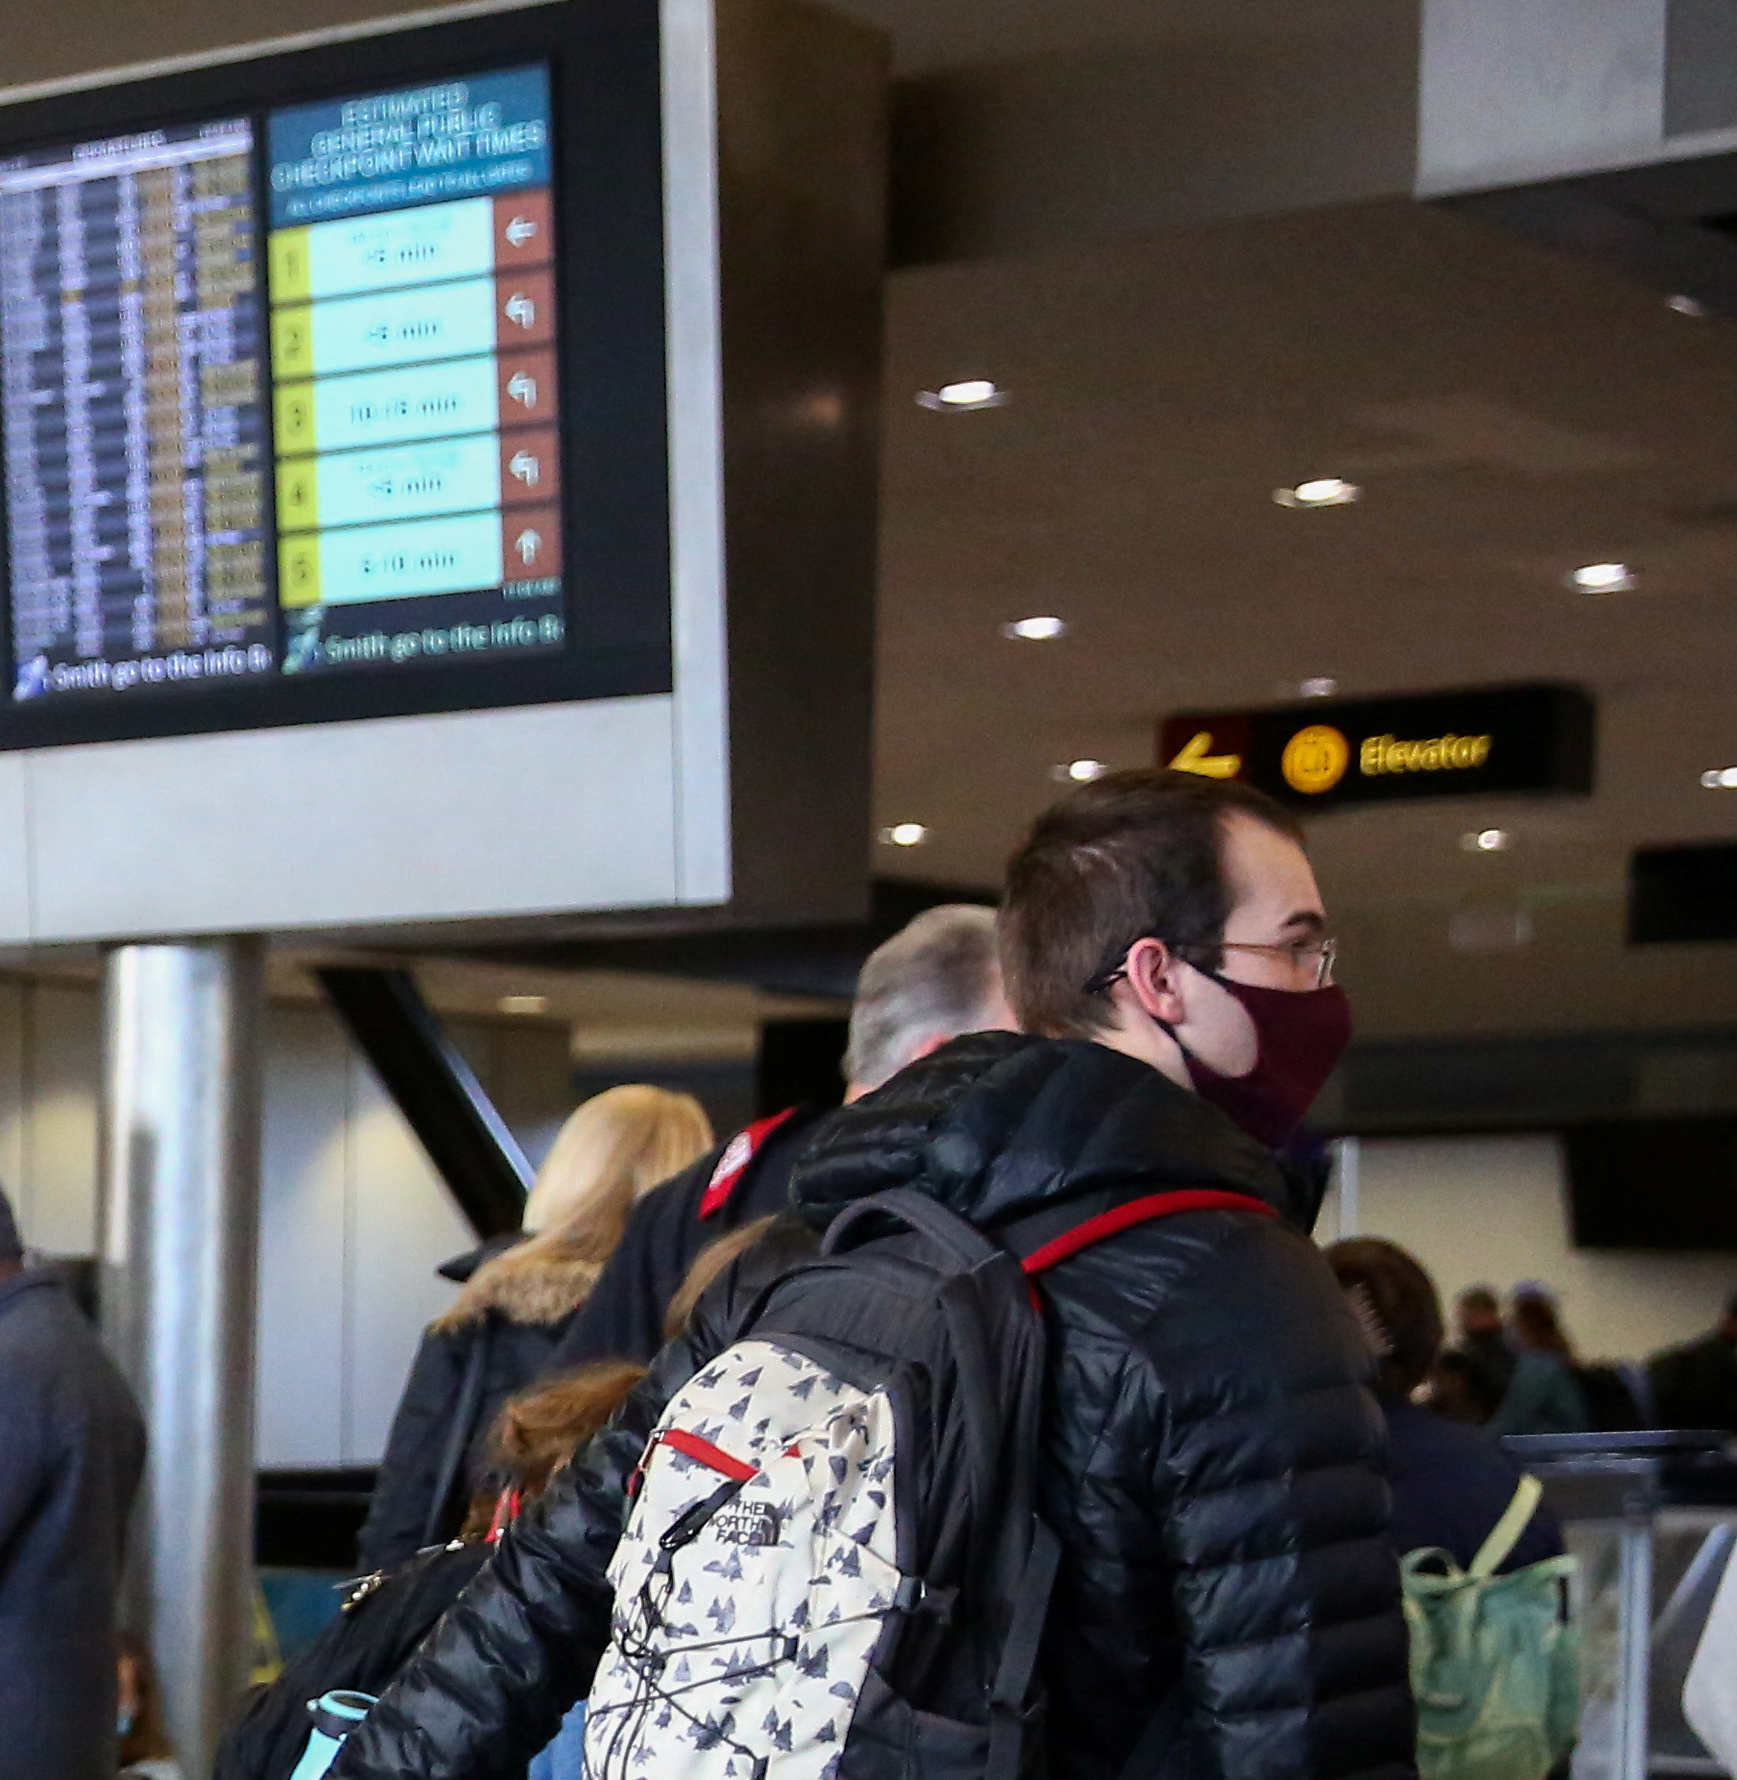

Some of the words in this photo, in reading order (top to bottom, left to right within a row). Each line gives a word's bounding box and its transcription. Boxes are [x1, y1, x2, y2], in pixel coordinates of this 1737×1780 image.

[311, 120, 416, 158] GENERAL
[417, 101, 502, 139] PUBLIC
[271, 147, 413, 192] CHECKPOINT
[413, 132, 472, 167] WAIT
[474, 119, 547, 156] TIMES
[390, 632, 422, 663] go
[422, 629, 450, 656] to
[450, 622, 490, 652] the
[112, 660, 141, 690] go
[141, 657, 167, 683] to
[167, 650, 204, 681] the
[204, 645, 247, 676] Info
[1360, 733, 1492, 776] Elevator
[708, 1515, 762, 1531] NORTH
[733, 1500, 765, 1515] THE
[716, 1529, 762, 1545] FACE
